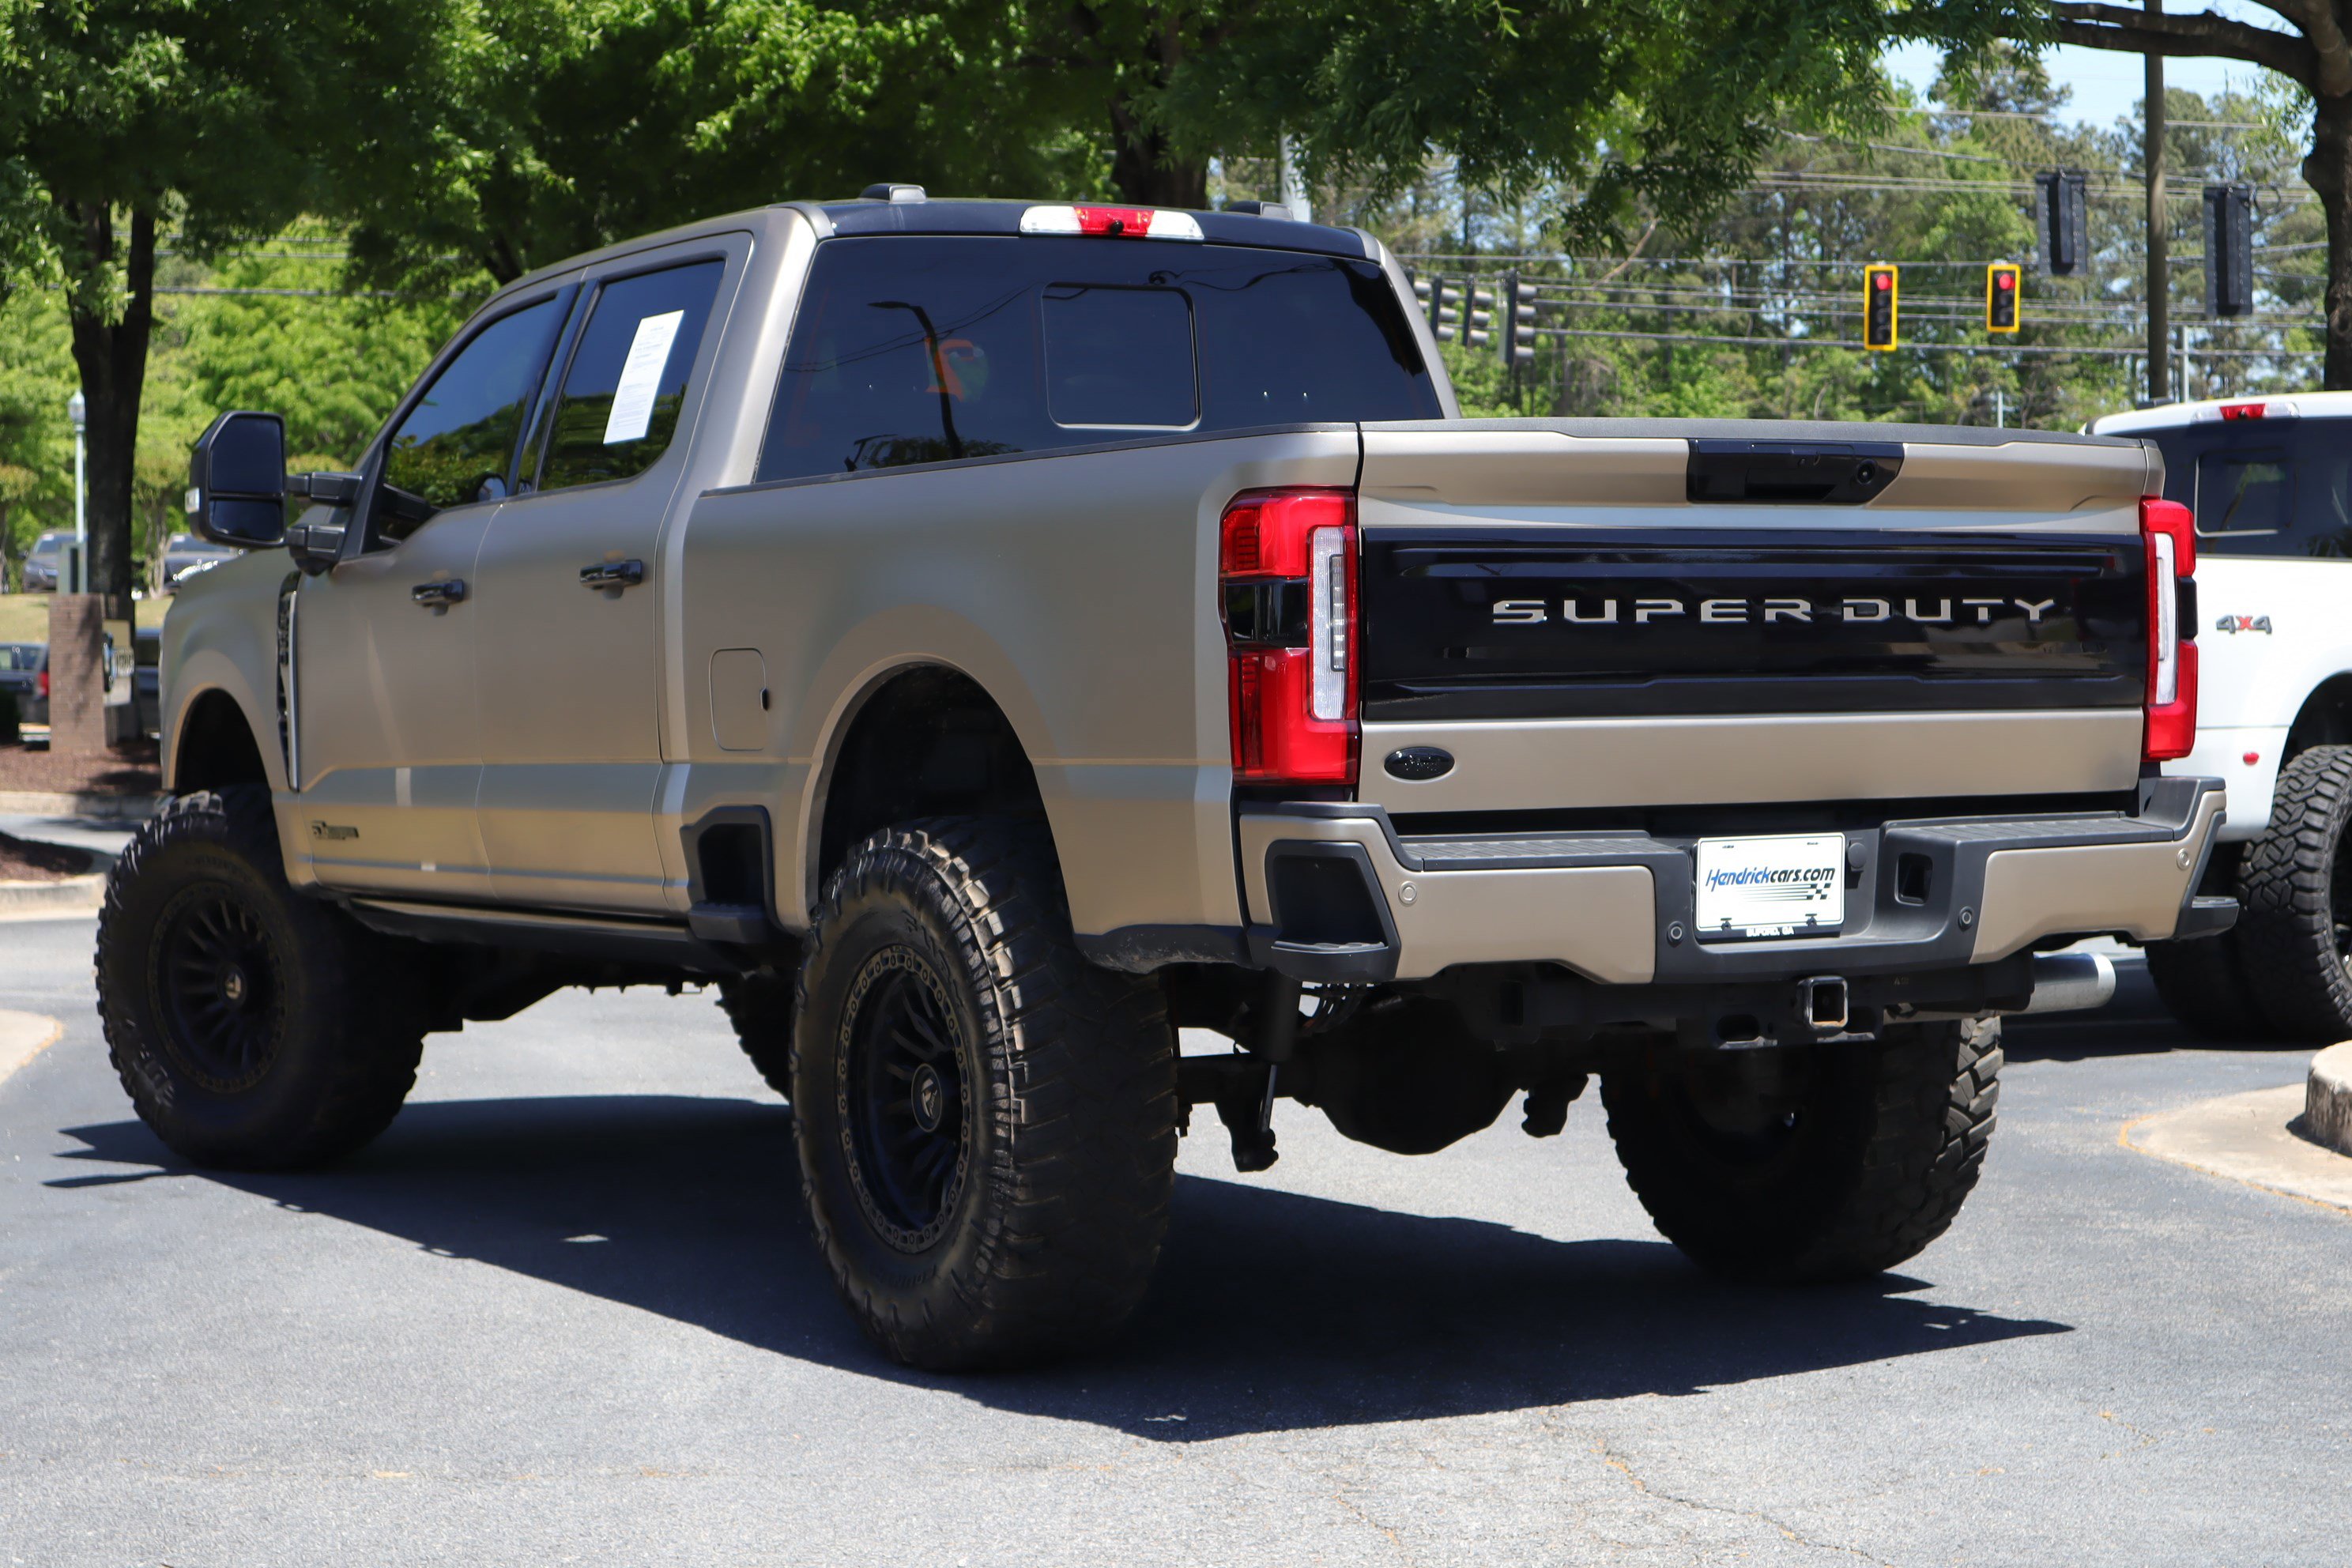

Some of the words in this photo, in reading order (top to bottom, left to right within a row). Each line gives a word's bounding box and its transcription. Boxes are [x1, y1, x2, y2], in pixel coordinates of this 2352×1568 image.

[1492, 597, 1815, 624] SUPER
[1841, 597, 2054, 623] DUTY
[1705, 866, 1836, 892] Hendrickcars.com
